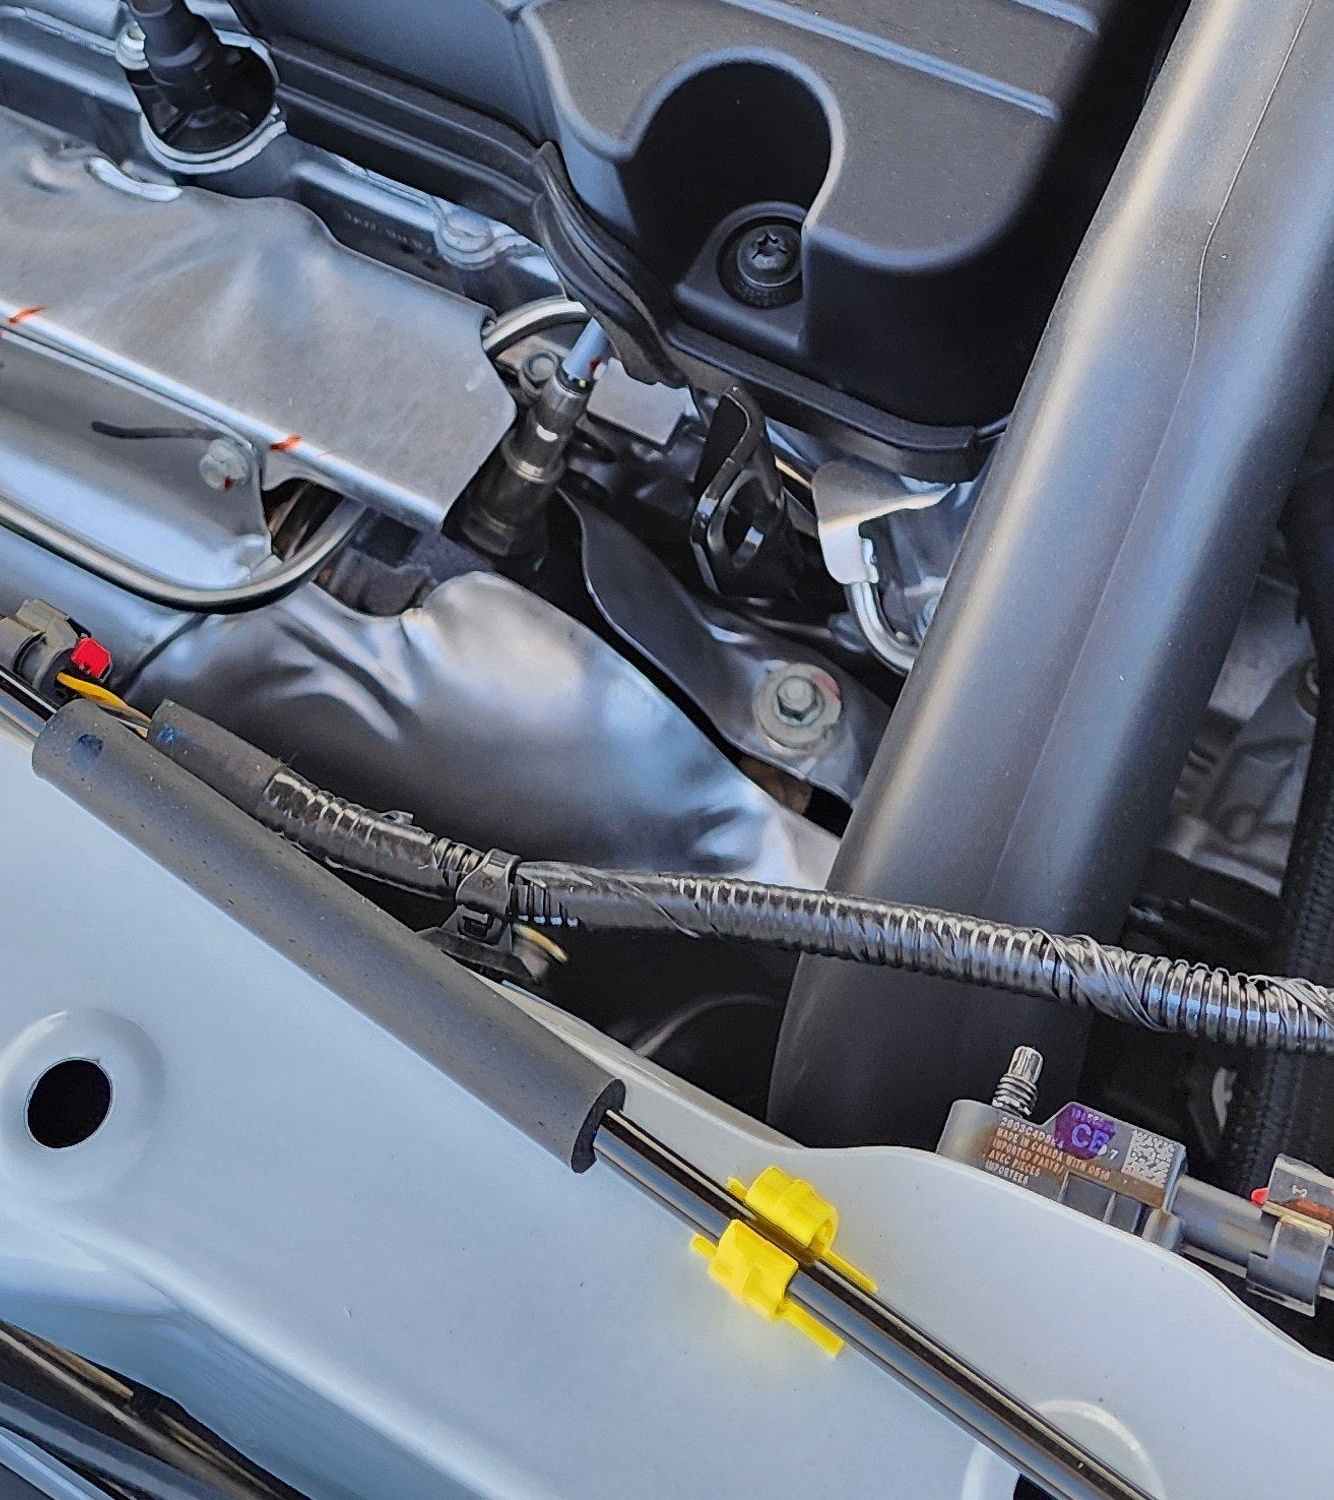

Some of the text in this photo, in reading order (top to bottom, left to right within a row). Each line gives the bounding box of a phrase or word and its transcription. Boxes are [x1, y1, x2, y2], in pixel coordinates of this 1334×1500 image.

[992, 1139, 1030, 1161] IMPORTED
[996, 1128, 1018, 1143] MADE
[1031, 1138, 1063, 1156] CANADA
[1067, 1155, 1087, 1171] WITH
[989, 1150, 1041, 1177] AVEC PIECES
